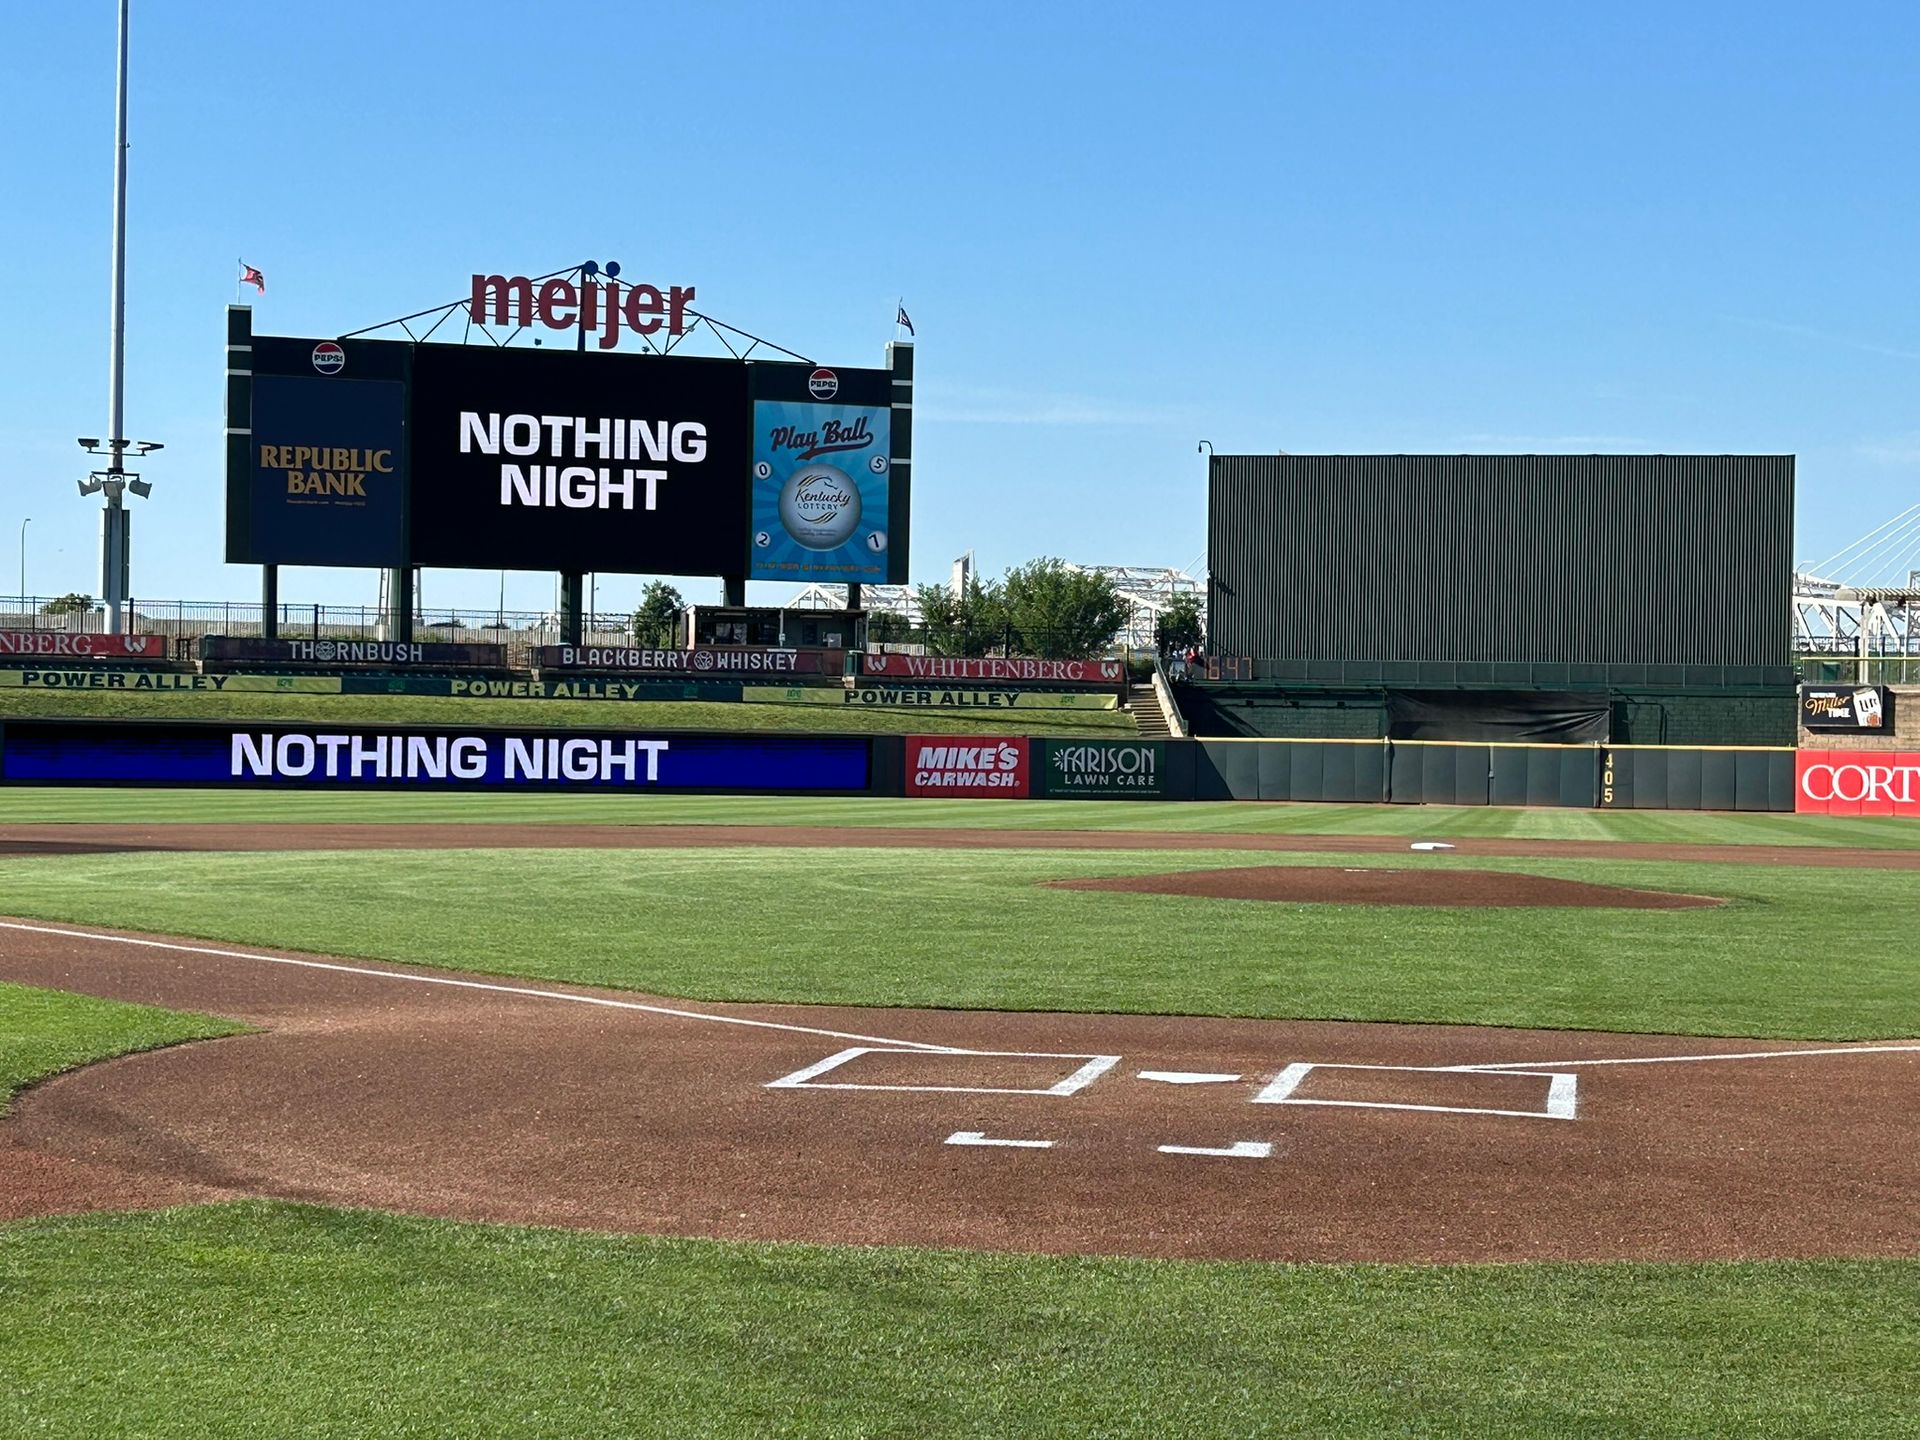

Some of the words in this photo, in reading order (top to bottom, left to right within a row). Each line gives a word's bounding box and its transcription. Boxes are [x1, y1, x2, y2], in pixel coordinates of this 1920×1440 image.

[471, 260, 695, 350] meijer
[314, 354, 343, 362] PEPSI
[810, 380, 836, 388] PEPSI
[459, 411, 707, 464] NOTHING
[770, 425, 819, 452] Play
[822, 416, 874, 445] Ball
[260, 445, 393, 473] REPUBLIC
[759, 464, 768, 476] 0
[287, 470, 367, 497] BANK
[500, 463, 667, 511] NIGHT
[794, 487, 851, 507] Kentucky
[798, 503, 838, 511] LOTTERY
[758, 533, 768, 546] 2
[288, 641, 423, 662] THORNBUSH
[562, 649, 690, 669] BLACKBERRY
[717, 652, 797, 671] WHISKEY
[905, 657, 1084, 680] WHITTENBERG
[22, 671, 126, 688] POWER
[134, 675, 229, 690] ALLEY
[450, 680, 546, 697] POWER
[552, 683, 640, 699] ALLEY
[844, 690, 932, 705] POWER
[939, 692, 1021, 707] ALLEY
[1805, 696, 1850, 715] Miller
[231, 733, 488, 779] NOTHING
[504, 738, 669, 781] NIGHT
[917, 742, 1020, 770] MIKE'S
[1063, 747, 1155, 774] FARISON
[915, 771, 1015, 787] CARWASH
[1064, 774, 1109, 785] LAWN
[1116, 775, 1155, 786] CARE
[1604, 754, 1614, 803] 405
[1802, 764, 1920, 802] CORT
